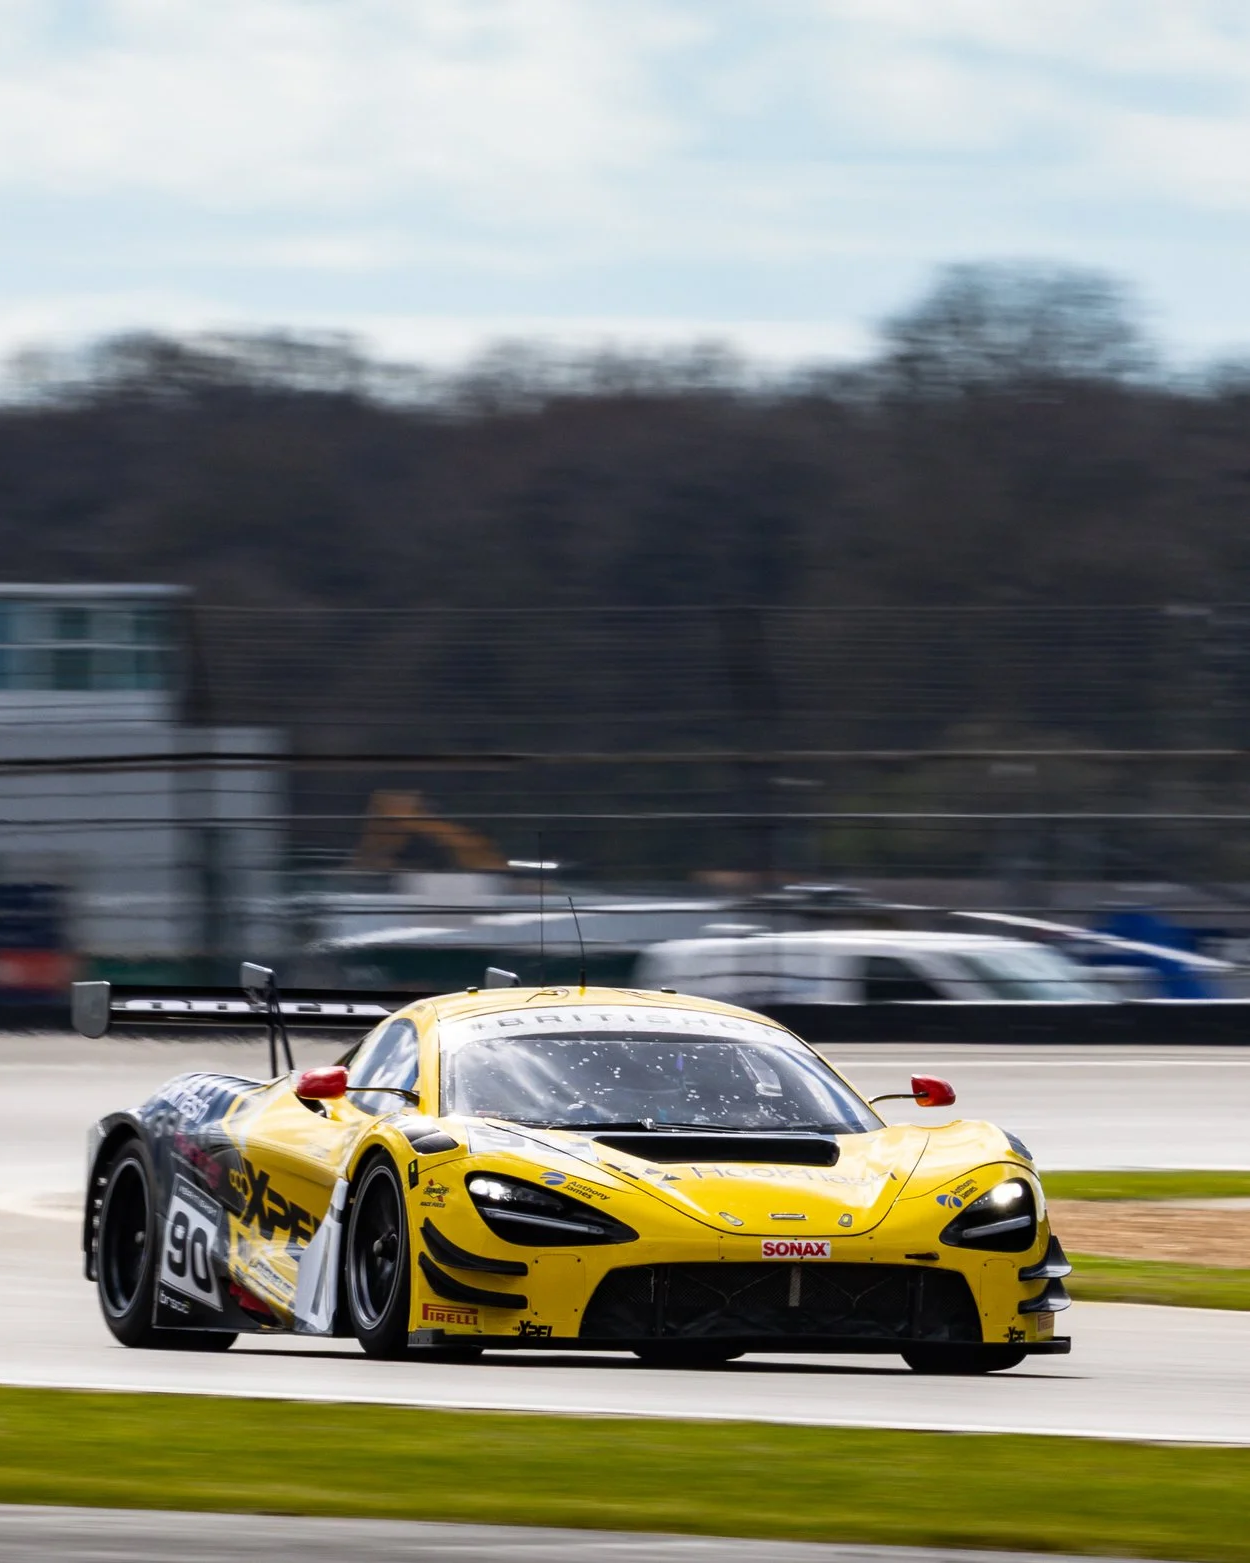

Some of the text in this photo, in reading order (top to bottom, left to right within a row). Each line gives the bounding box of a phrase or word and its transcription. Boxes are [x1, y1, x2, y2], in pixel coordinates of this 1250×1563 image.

[562, 1185, 593, 1200] James
[569, 1180, 611, 1201] Anthony
[167, 1210, 213, 1294] 90
[762, 1242, 827, 1257] SONAX
[422, 1303, 479, 1326] PIRELLI
